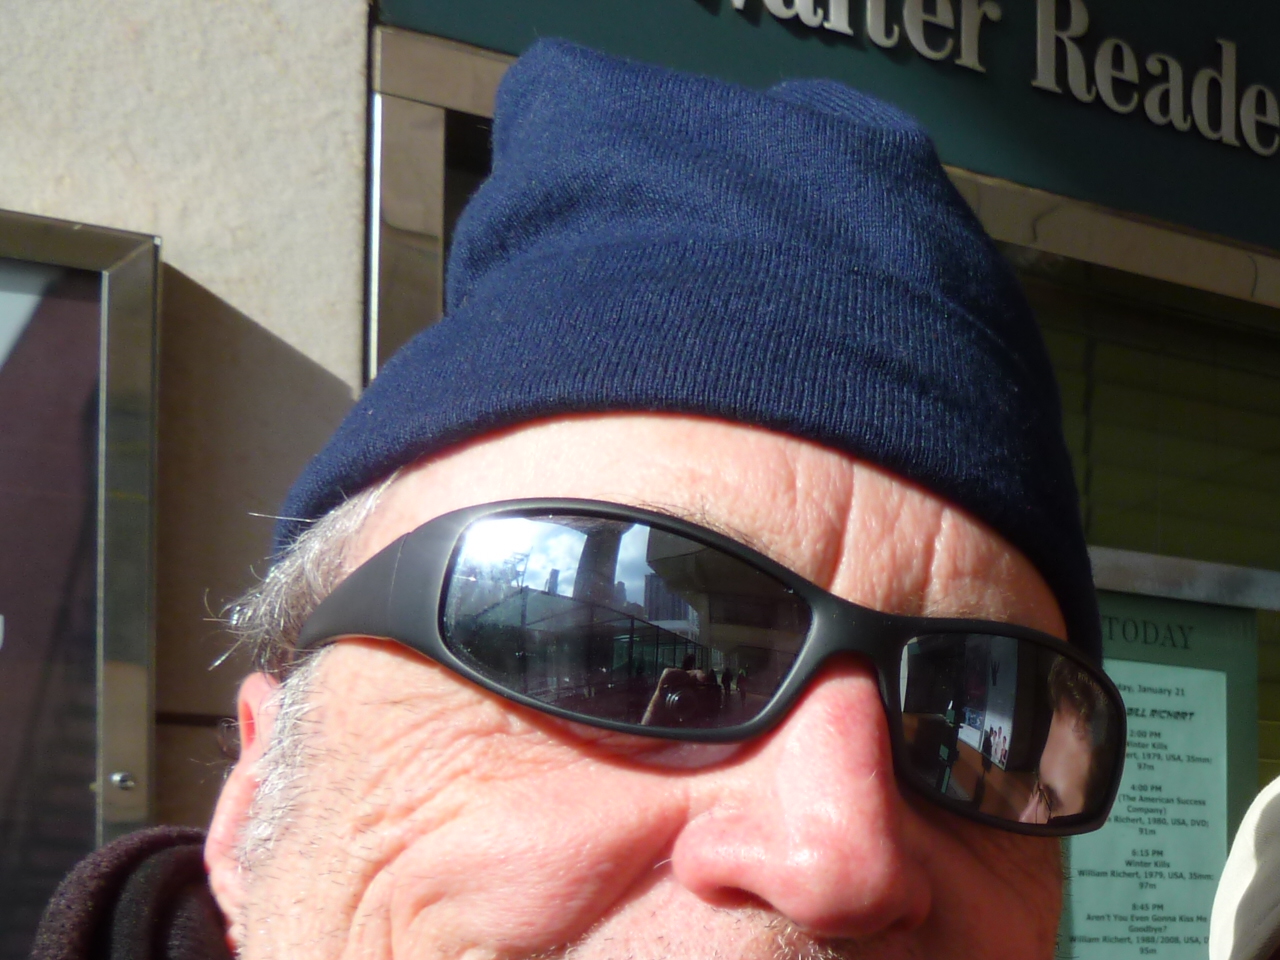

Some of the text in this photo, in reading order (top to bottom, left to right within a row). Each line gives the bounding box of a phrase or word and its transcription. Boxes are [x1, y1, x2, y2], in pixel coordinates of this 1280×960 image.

[1031, 0, 1280, 156] Reade
[1102, 615, 1194, 650] TODAY
[1138, 684, 1172, 697] January
[1175, 687, 1186, 696] 21
[1149, 731, 1162, 739] PM
[1152, 742, 1168, 750] Kills
[1131, 784, 1148, 792] 4:00
[1139, 795, 1174, 804] American
[1177, 796, 1206, 806] Success
[1127, 805, 1167, 815] Company)
[1131, 849, 1164, 857] 6:15 PM
[1125, 859, 1170, 868] Winter Kills
[1077, 869, 1108, 878] William
[1110, 870, 1141, 879] Richert,
[1138, 881, 1157, 890] 97m
[1151, 903, 1164, 911] PM
[1086, 913, 1208, 923] Aren't You Even Gonna Kiss Me
[1127, 925, 1167, 934] Goodbye?
[1069, 935, 1100, 944] William
[1102, 936, 1133, 944] Richert,
